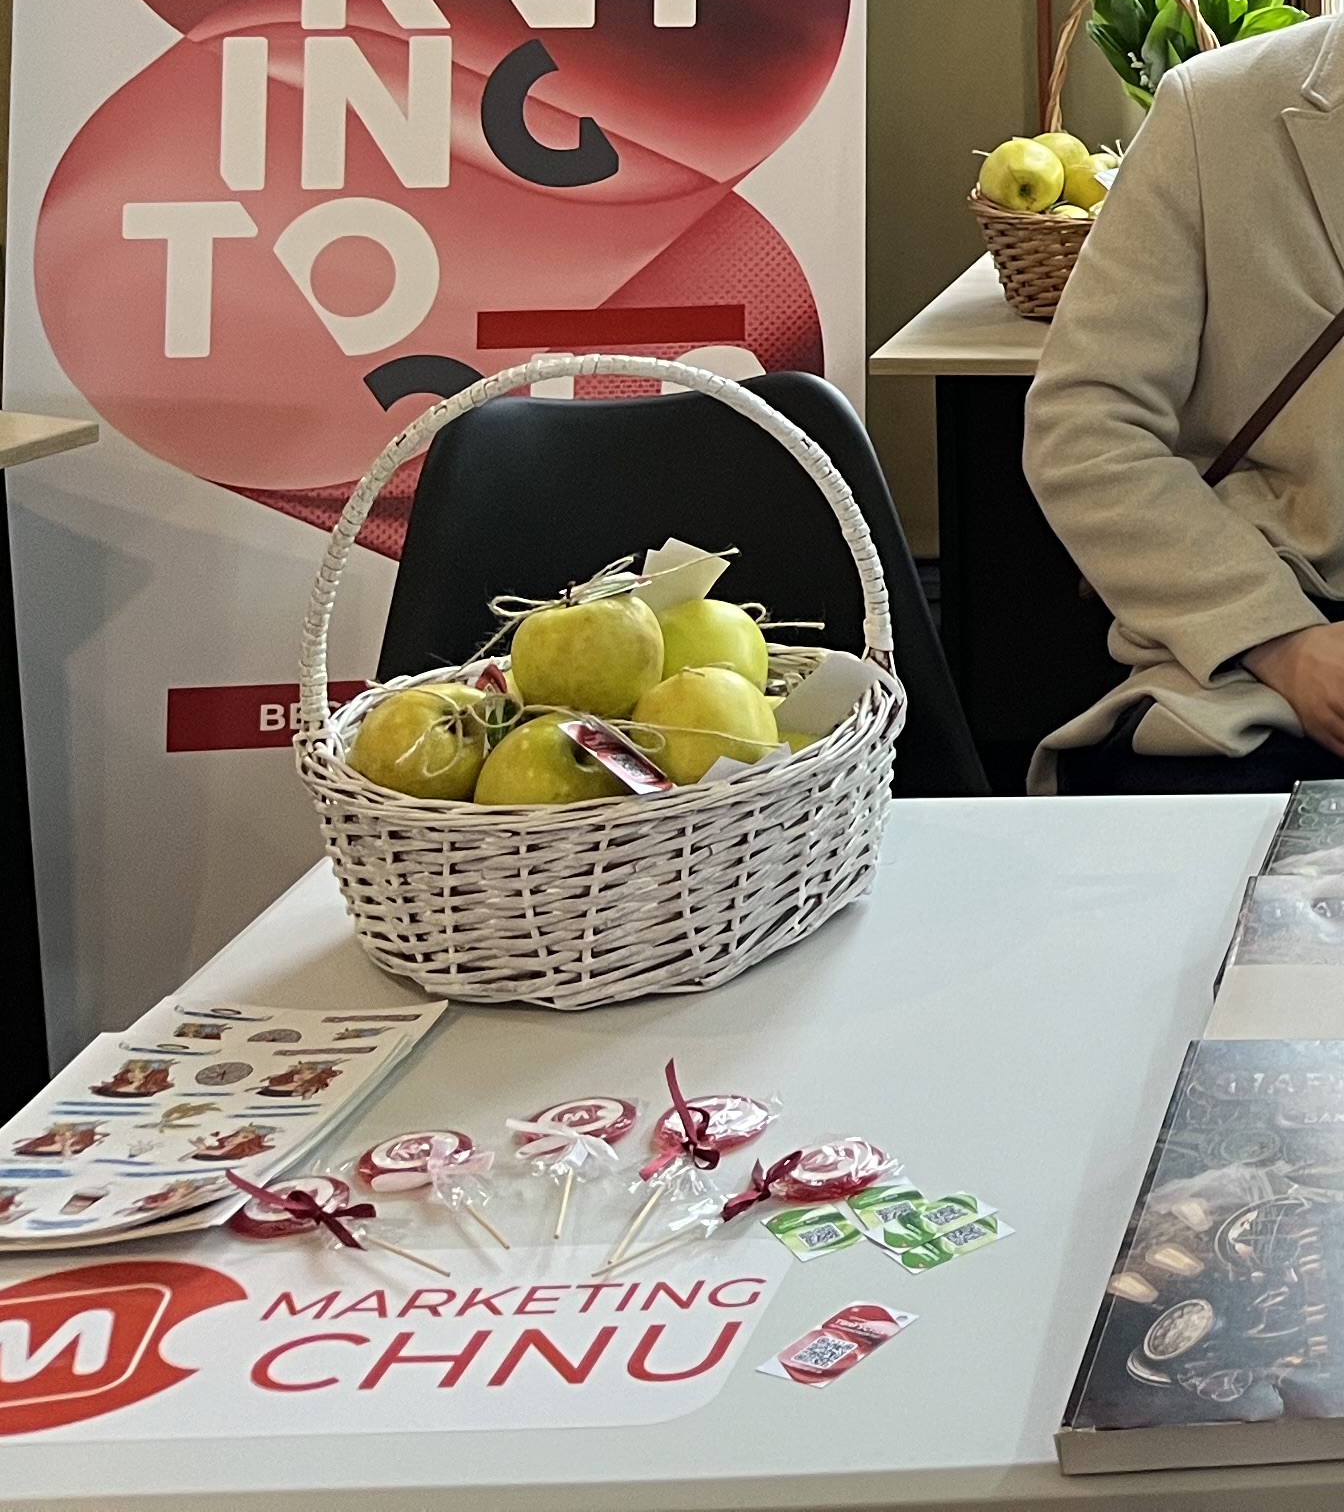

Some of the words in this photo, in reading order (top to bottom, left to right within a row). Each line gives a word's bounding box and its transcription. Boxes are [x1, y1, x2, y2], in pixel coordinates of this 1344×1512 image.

[219, 34, 620, 192] ING
[121, 196, 441, 359] TO
[250, 1320, 743, 1392] CHNU
[260, 1277, 768, 1321] MARKETING
